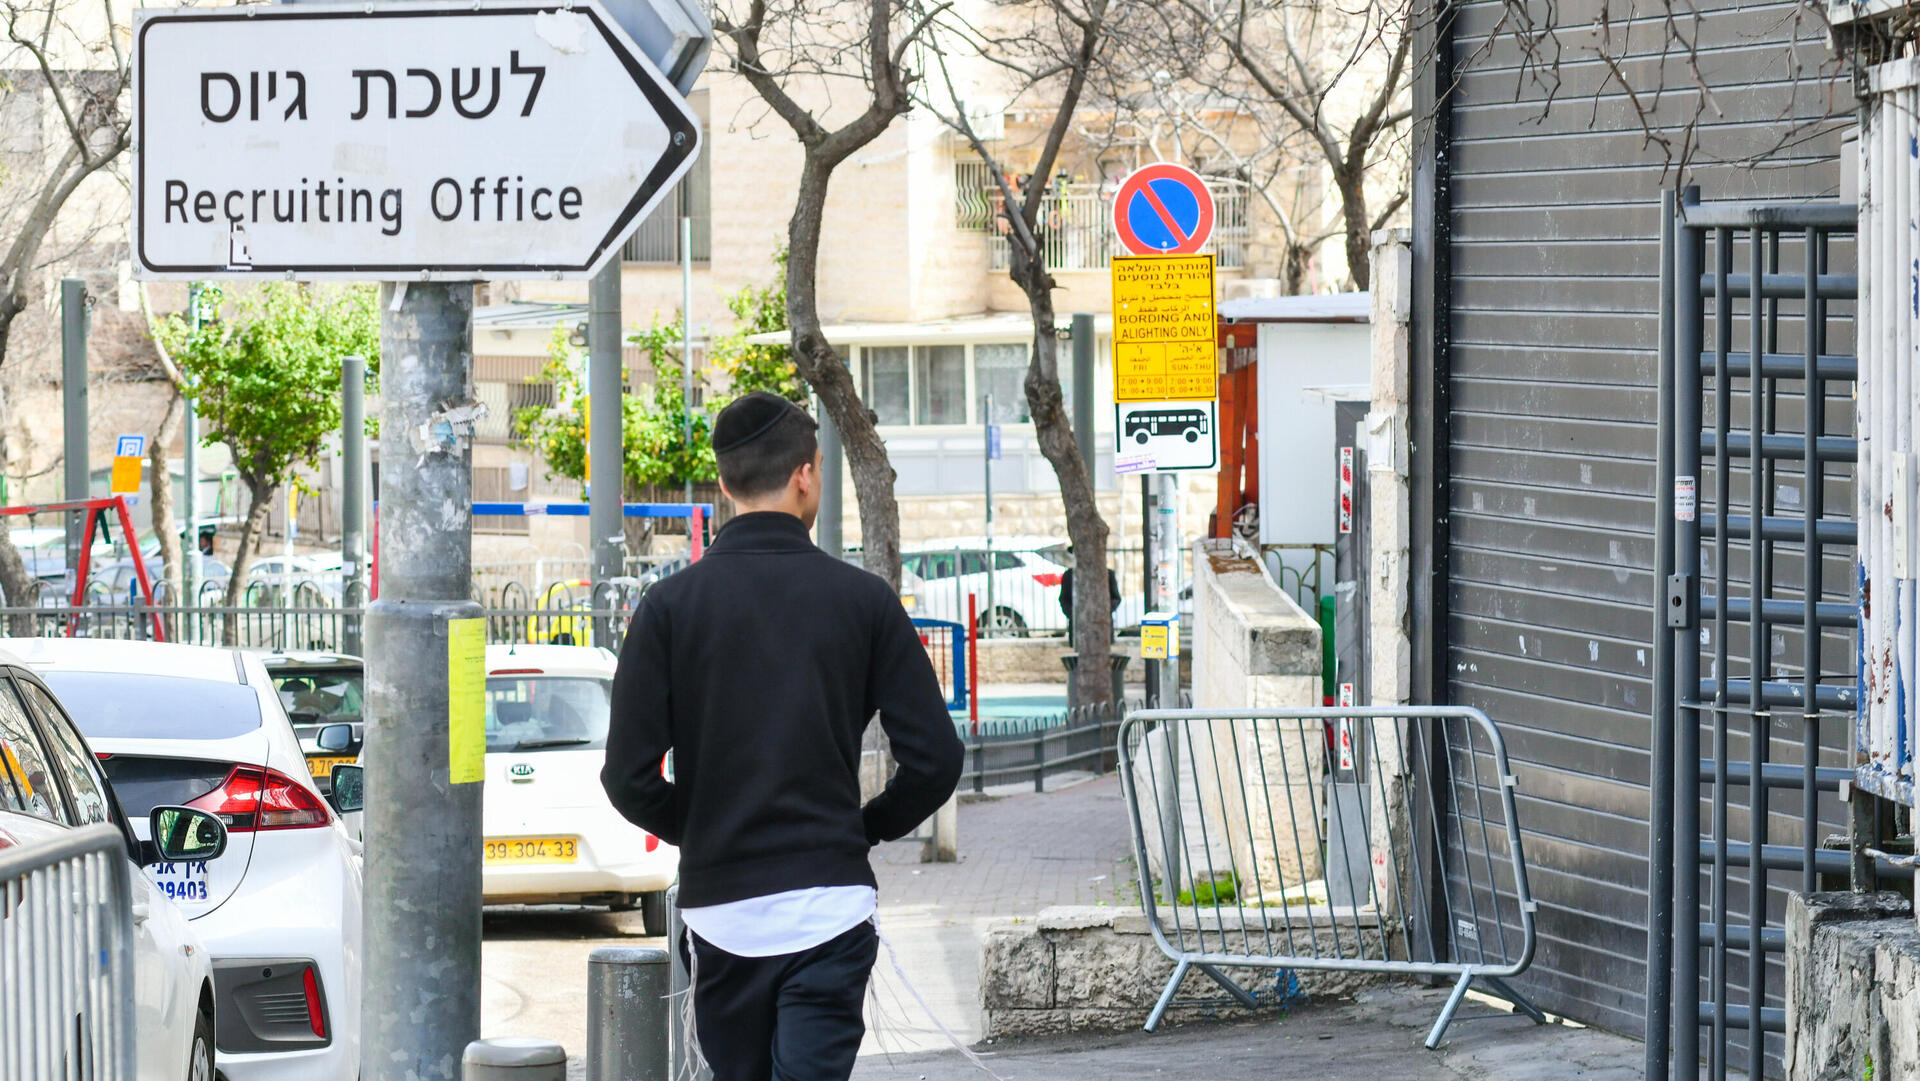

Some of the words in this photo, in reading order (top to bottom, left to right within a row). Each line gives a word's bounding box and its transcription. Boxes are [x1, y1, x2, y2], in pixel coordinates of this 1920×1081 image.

[351, 51, 545, 120] לשכת
[201, 71, 307, 122] גיוס
[166, 178, 401, 236] Recruiting
[431, 177, 582, 221] Office
[1117, 263, 1160, 272] העלאה
[1167, 263, 1208, 271] מותרת
[1118, 273, 1160, 282] נוסעים
[1166, 272, 1210, 280] והורדת
[1146, 281, 1180, 289] בלבד
[1119, 313, 1180, 324] BORDING
[1184, 312, 1211, 322] AND
[1122, 327, 1178, 339] ALIGHTING
[1181, 326, 1207, 337] ONLY
[512, 765, 533, 775] KIA
